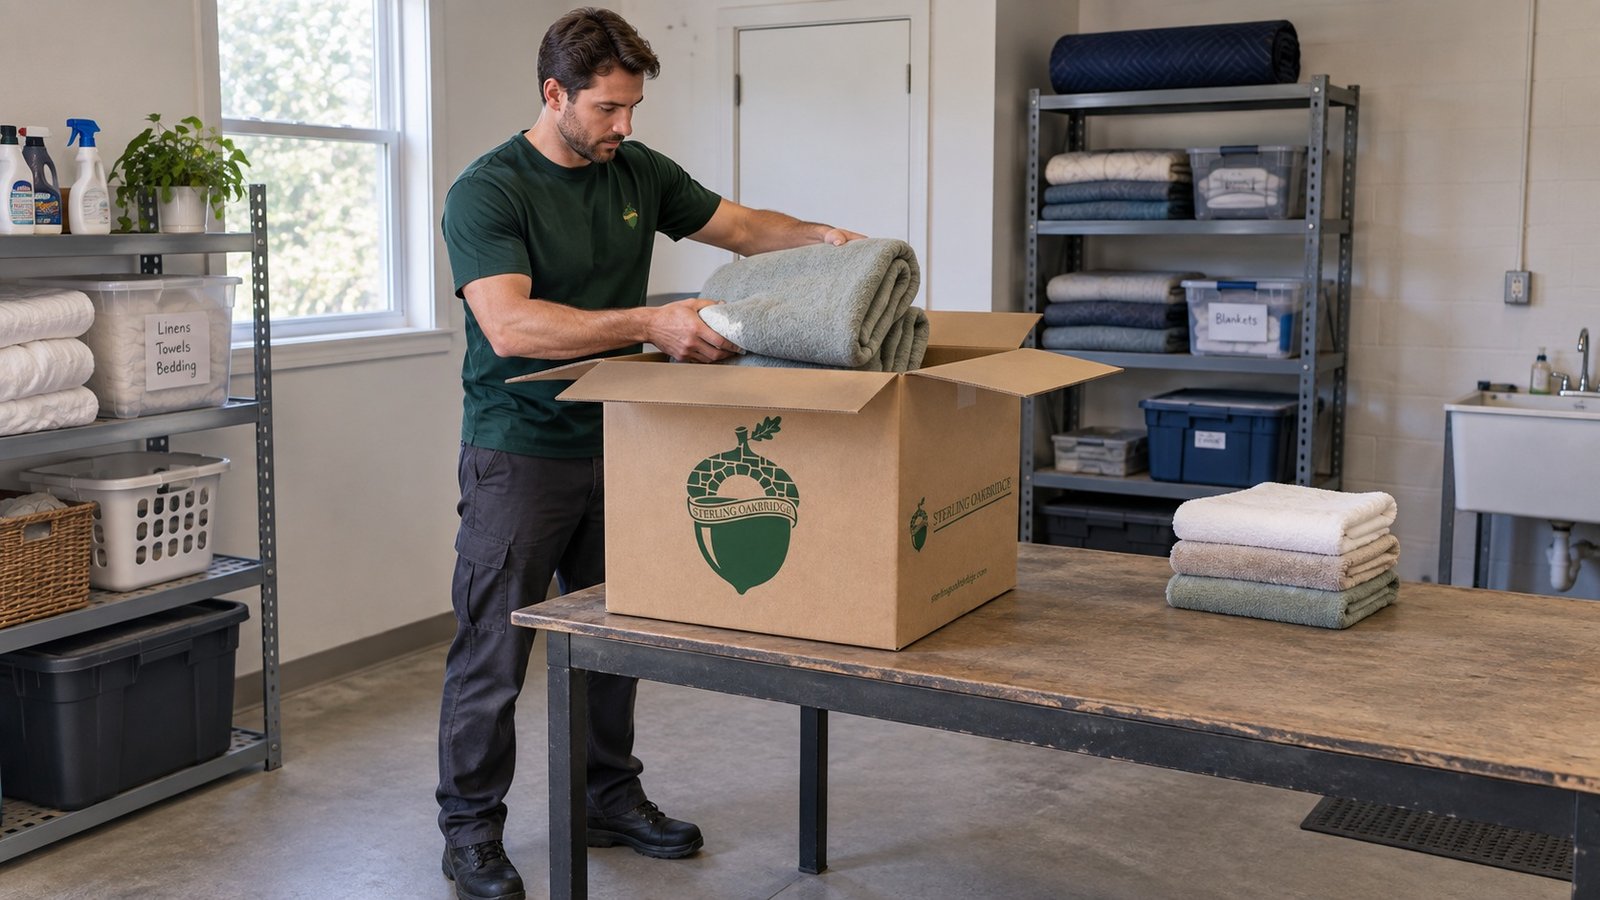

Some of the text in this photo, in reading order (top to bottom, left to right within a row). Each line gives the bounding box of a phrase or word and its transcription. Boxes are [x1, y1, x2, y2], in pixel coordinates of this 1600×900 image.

[1216, 312, 1258, 326] Blankets
[158, 321, 191, 335] Linens
[156, 340, 191, 355] Towels
[156, 360, 197, 378] Bedding
[933, 477, 1011, 526] STERLING OAKBRIDGE
[692, 501, 792, 519] STERLING OAKBRIDGE
